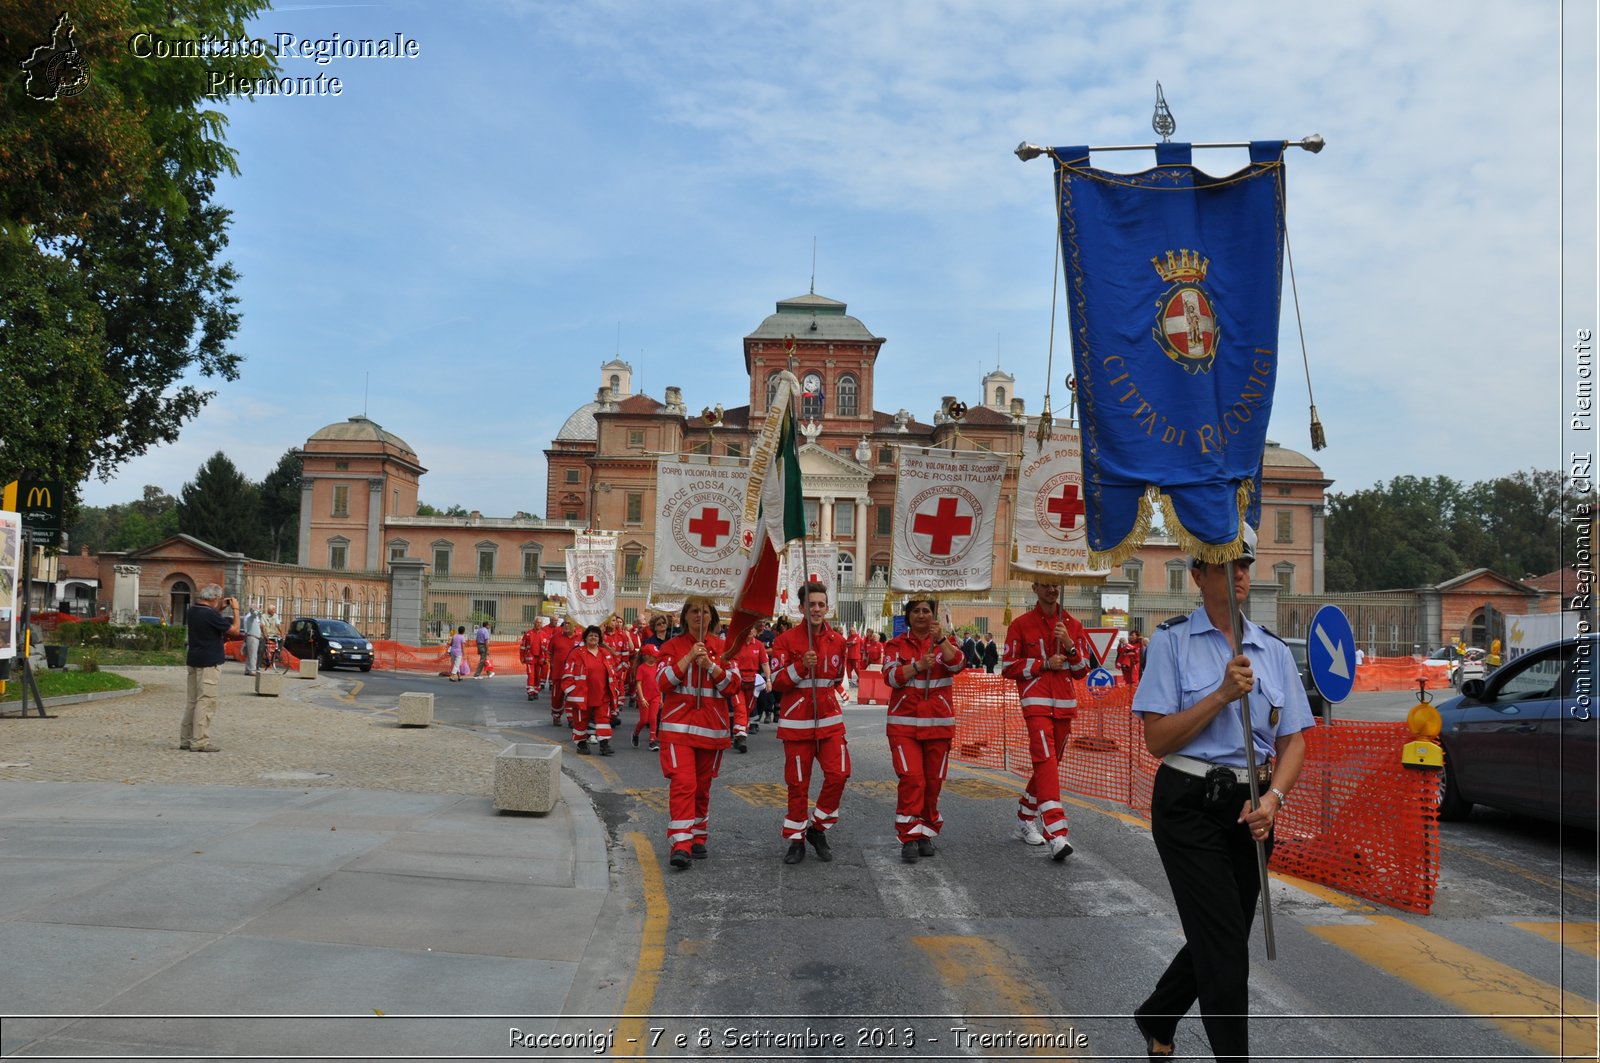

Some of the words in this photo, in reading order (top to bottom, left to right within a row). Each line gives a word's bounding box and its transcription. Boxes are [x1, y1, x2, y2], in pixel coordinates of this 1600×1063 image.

[1161, 425, 1186, 446] DI
[744, 477, 763, 523] COMITATO
[762, 406, 781, 439] CUNEO
[926, 461, 957, 472] VOLONTARI
[959, 463, 969, 472] DEL
[971, 465, 1000, 473] SOCCORSO
[1024, 454, 1052, 477] CROCE
[662, 467, 682, 477] CORPO
[684, 469, 717, 478] VOLONTARI
[718, 470, 729, 478] DEL
[731, 471, 748, 480] SOCC
[900, 469, 929, 480] CROCE
[932, 472, 962, 482] ROSSA
[964, 473, 1003, 483] ITALIANA
[662, 488, 688, 518] CROCE
[689, 480, 725, 492] ROSSA
[727, 486, 745, 504] ITAL
[685, 500, 693, 509] DI
[693, 493, 727, 505] GINEVRA
[909, 486, 954, 514] CONVENZIONE
[962, 490, 982, 517] GINEVRA
[728, 503, 738, 512] 22
[673, 509, 699, 557] CONVENZIONE
[1025, 545, 1087, 557] DELEGAZIONE
[670, 564, 732, 575] DELEGAZIONE
[898, 568, 934, 577] COMITATO
[937, 568, 968, 577] LOCALE
[971, 567, 980, 575] DI
[1036, 560, 1086, 572] PAESANA
[685, 577, 727, 589] BARGE
[909, 579, 968, 589] RACCONIGI
